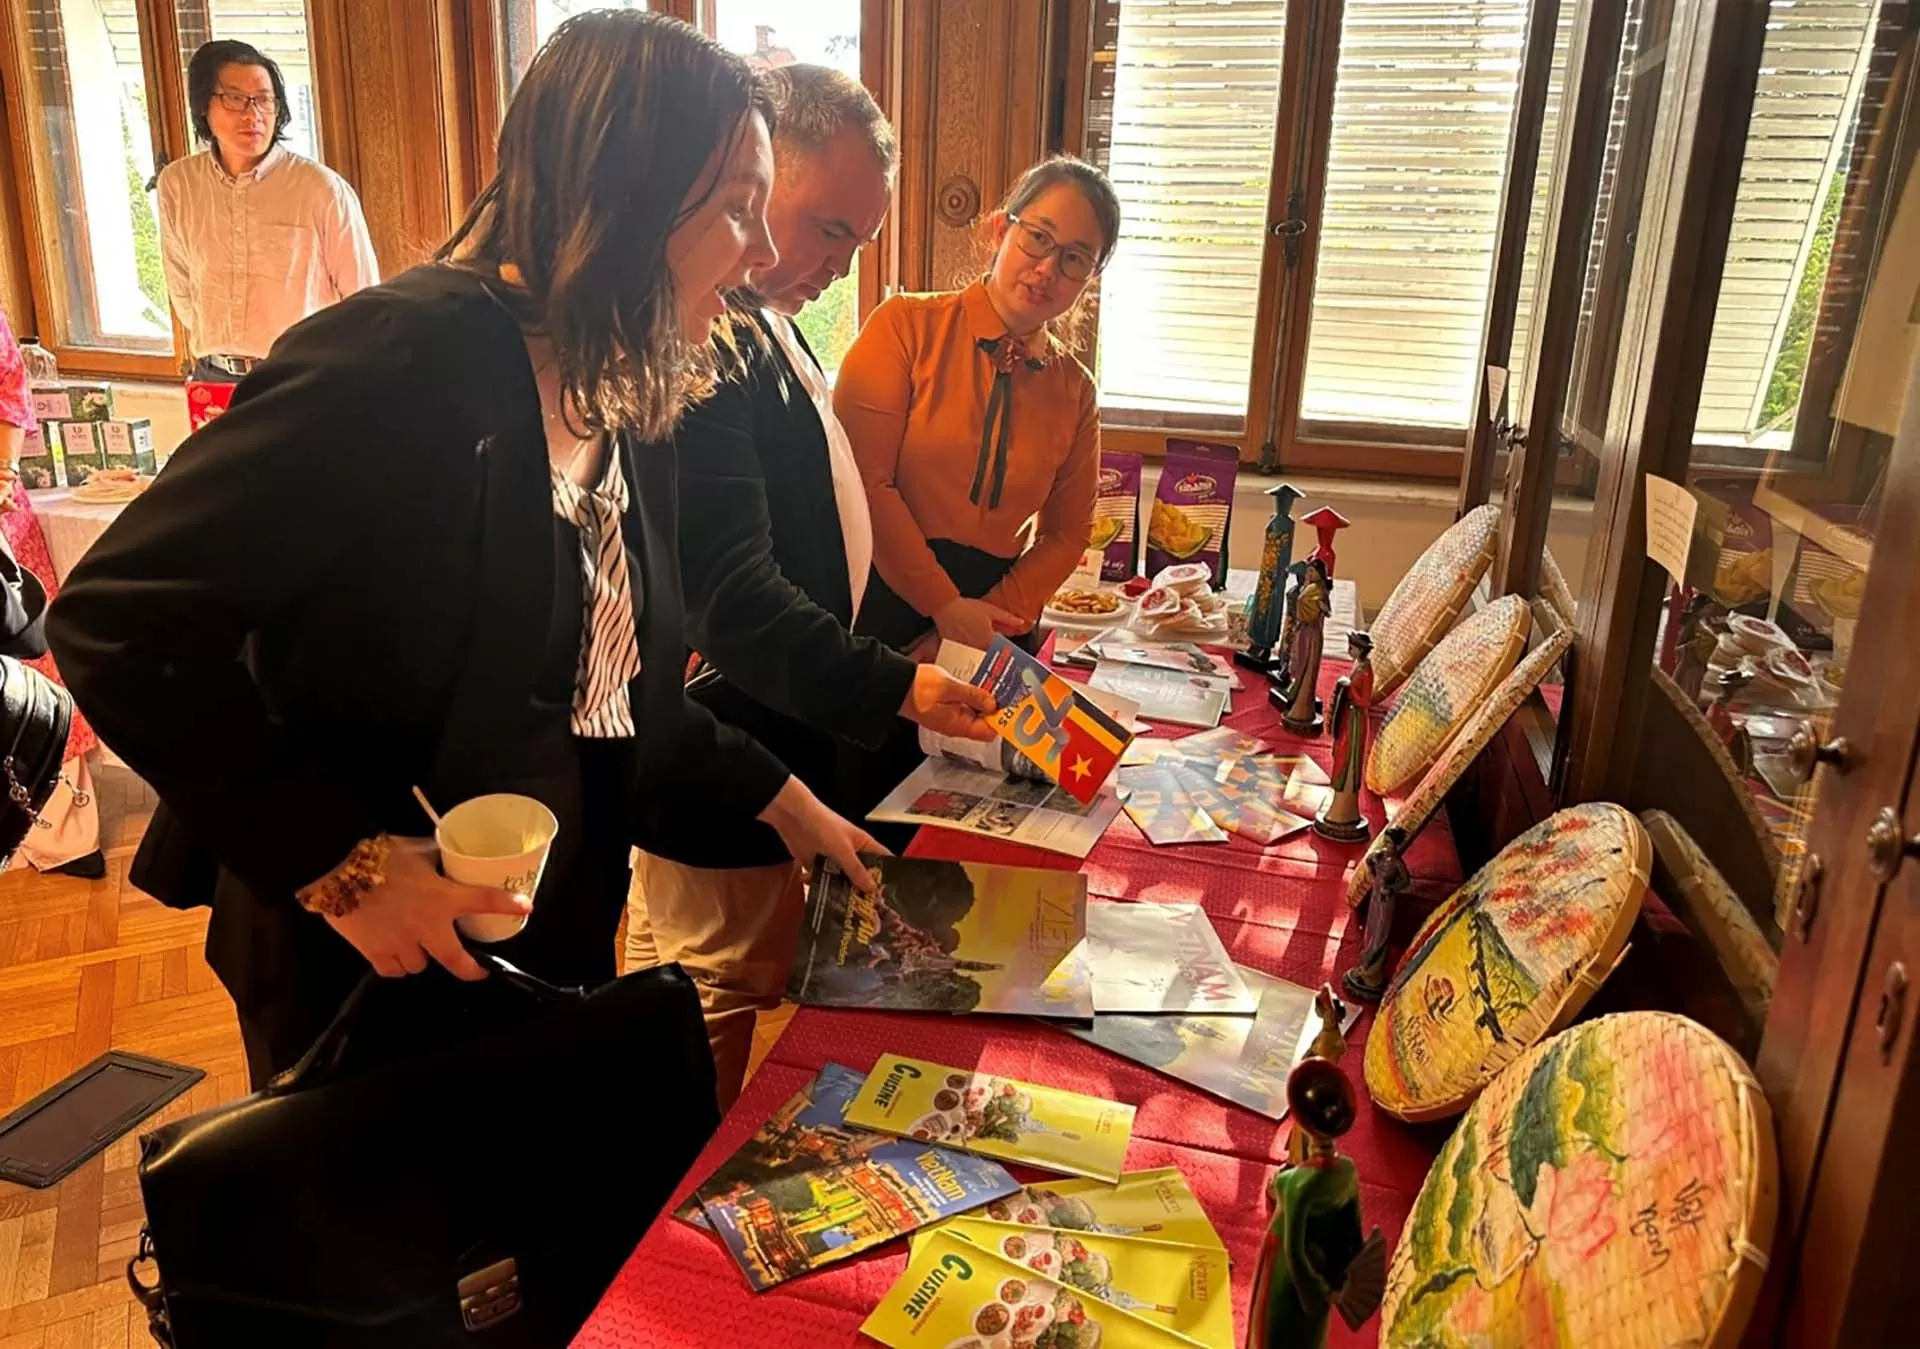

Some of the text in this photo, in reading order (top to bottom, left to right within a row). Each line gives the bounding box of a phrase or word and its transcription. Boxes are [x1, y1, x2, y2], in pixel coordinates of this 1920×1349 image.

[998, 683, 1032, 729] YEARS
[1014, 667, 1075, 765] 75
[1158, 903, 1237, 1001] VIETNAM
[874, 1064, 922, 1108] CUISINE
[903, 1254, 974, 1319] CUISINE
